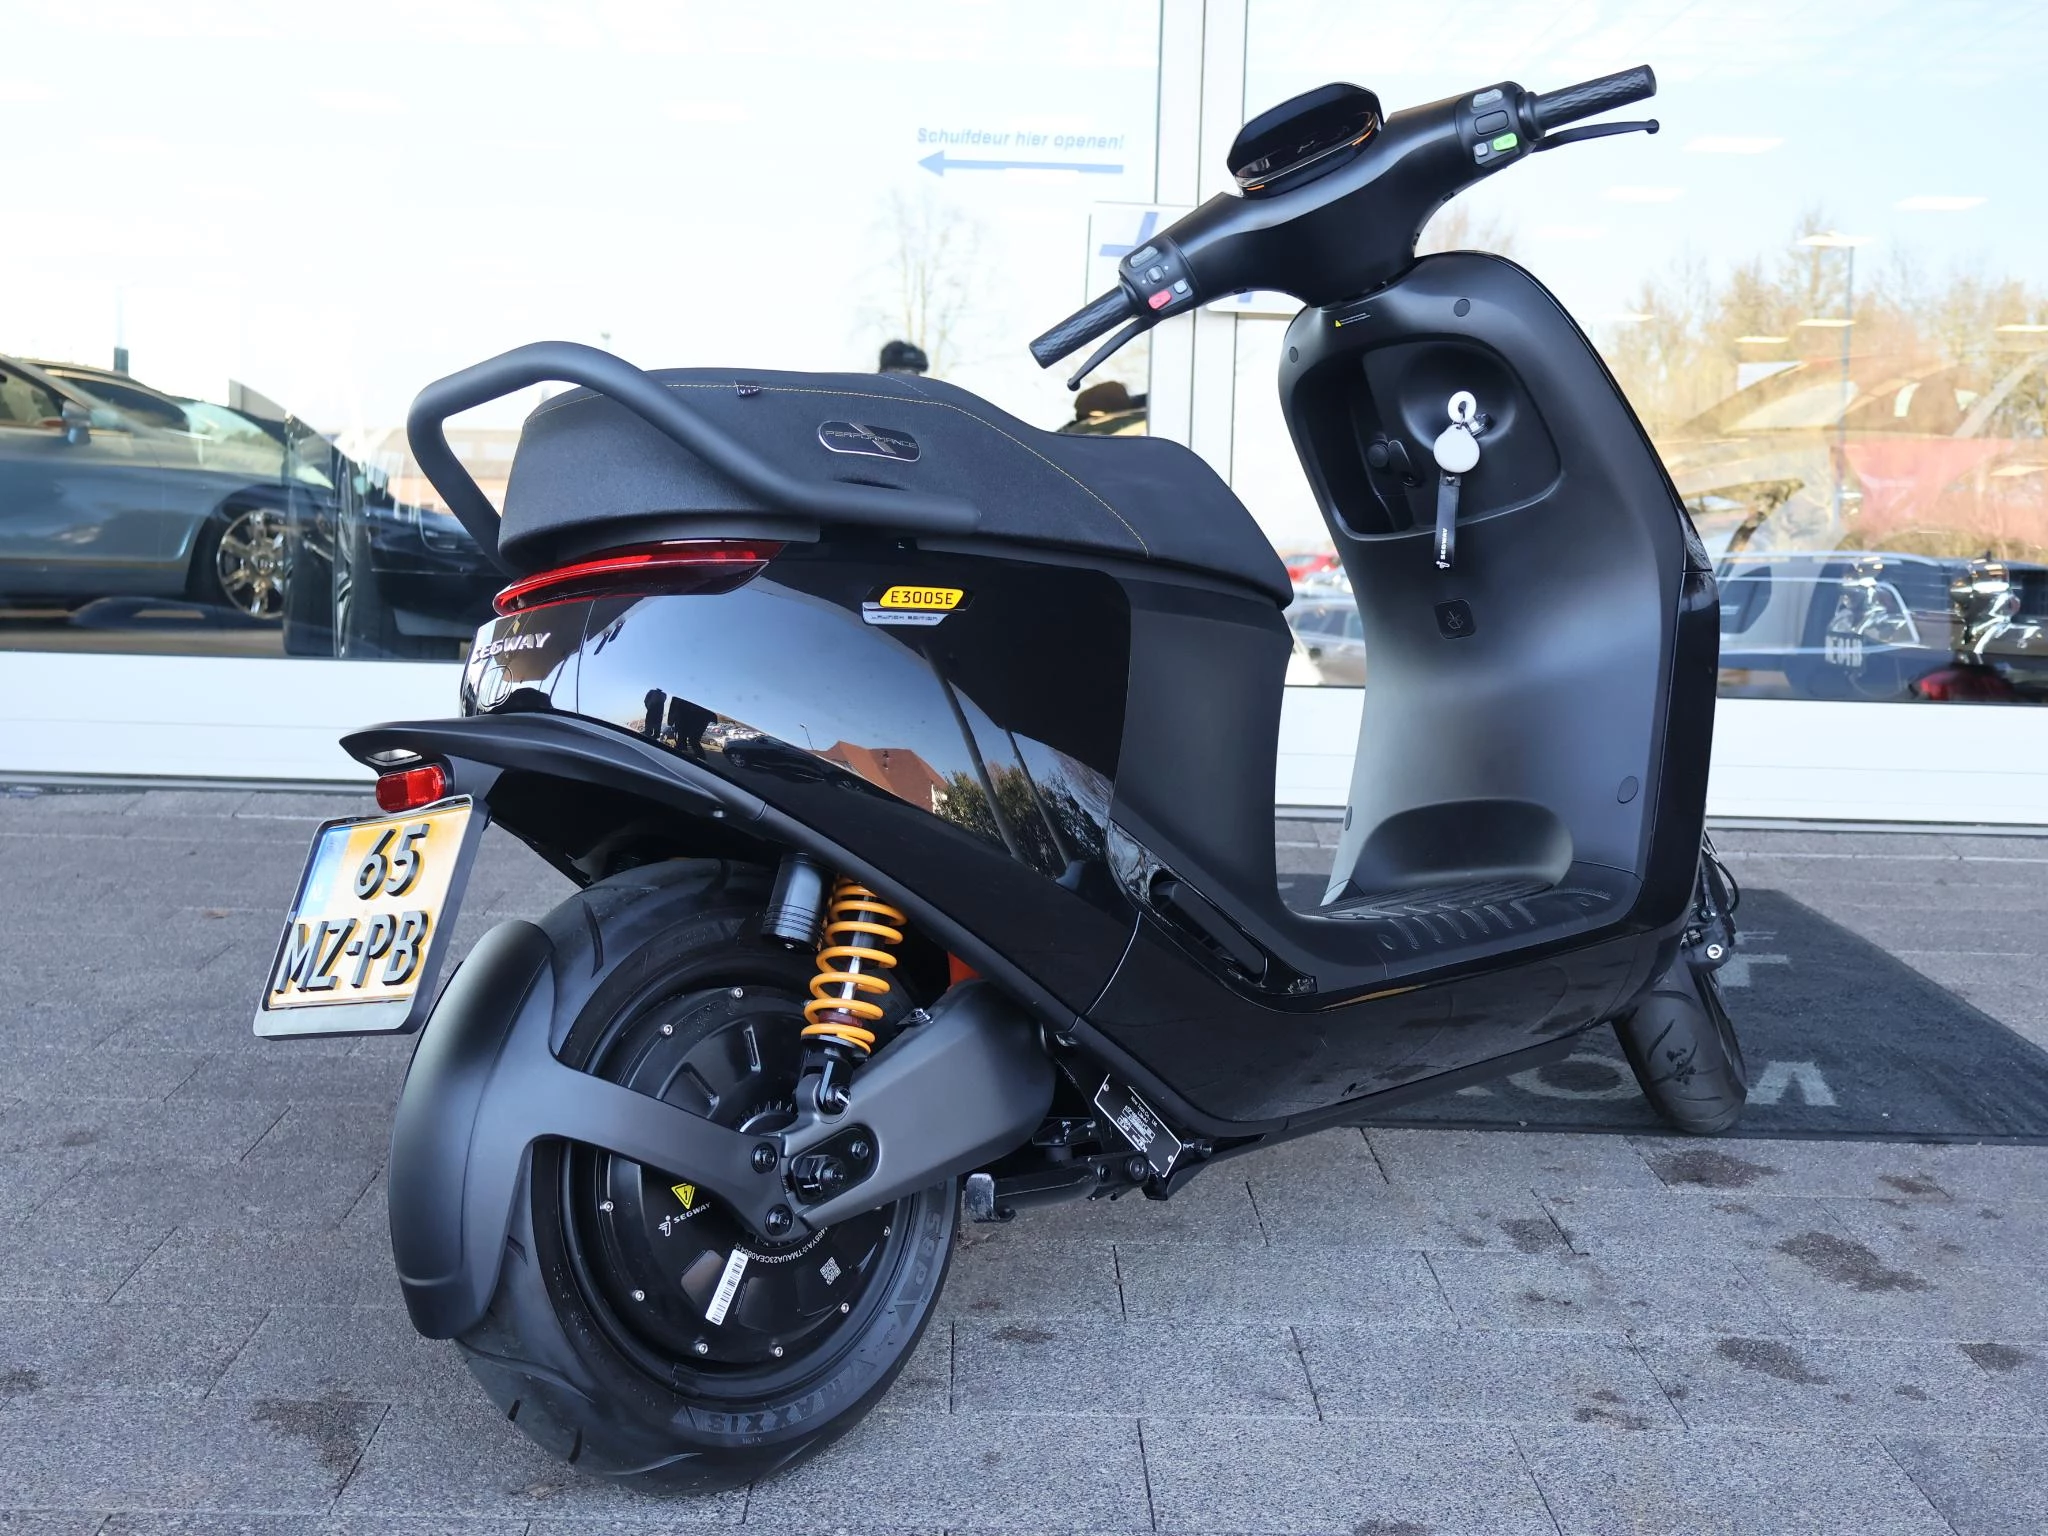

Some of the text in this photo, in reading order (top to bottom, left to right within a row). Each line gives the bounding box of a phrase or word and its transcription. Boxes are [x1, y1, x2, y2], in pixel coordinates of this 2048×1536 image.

[917, 127, 1125, 150] Schuifdeur hier openen!
[824, 429, 918, 449] PERFORMANCE
[891, 590, 954, 605] E300SE
[353, 823, 431, 901] 65
[274, 909, 430, 994] MZ-PB
[673, 1202, 711, 1224] SEGWAY
